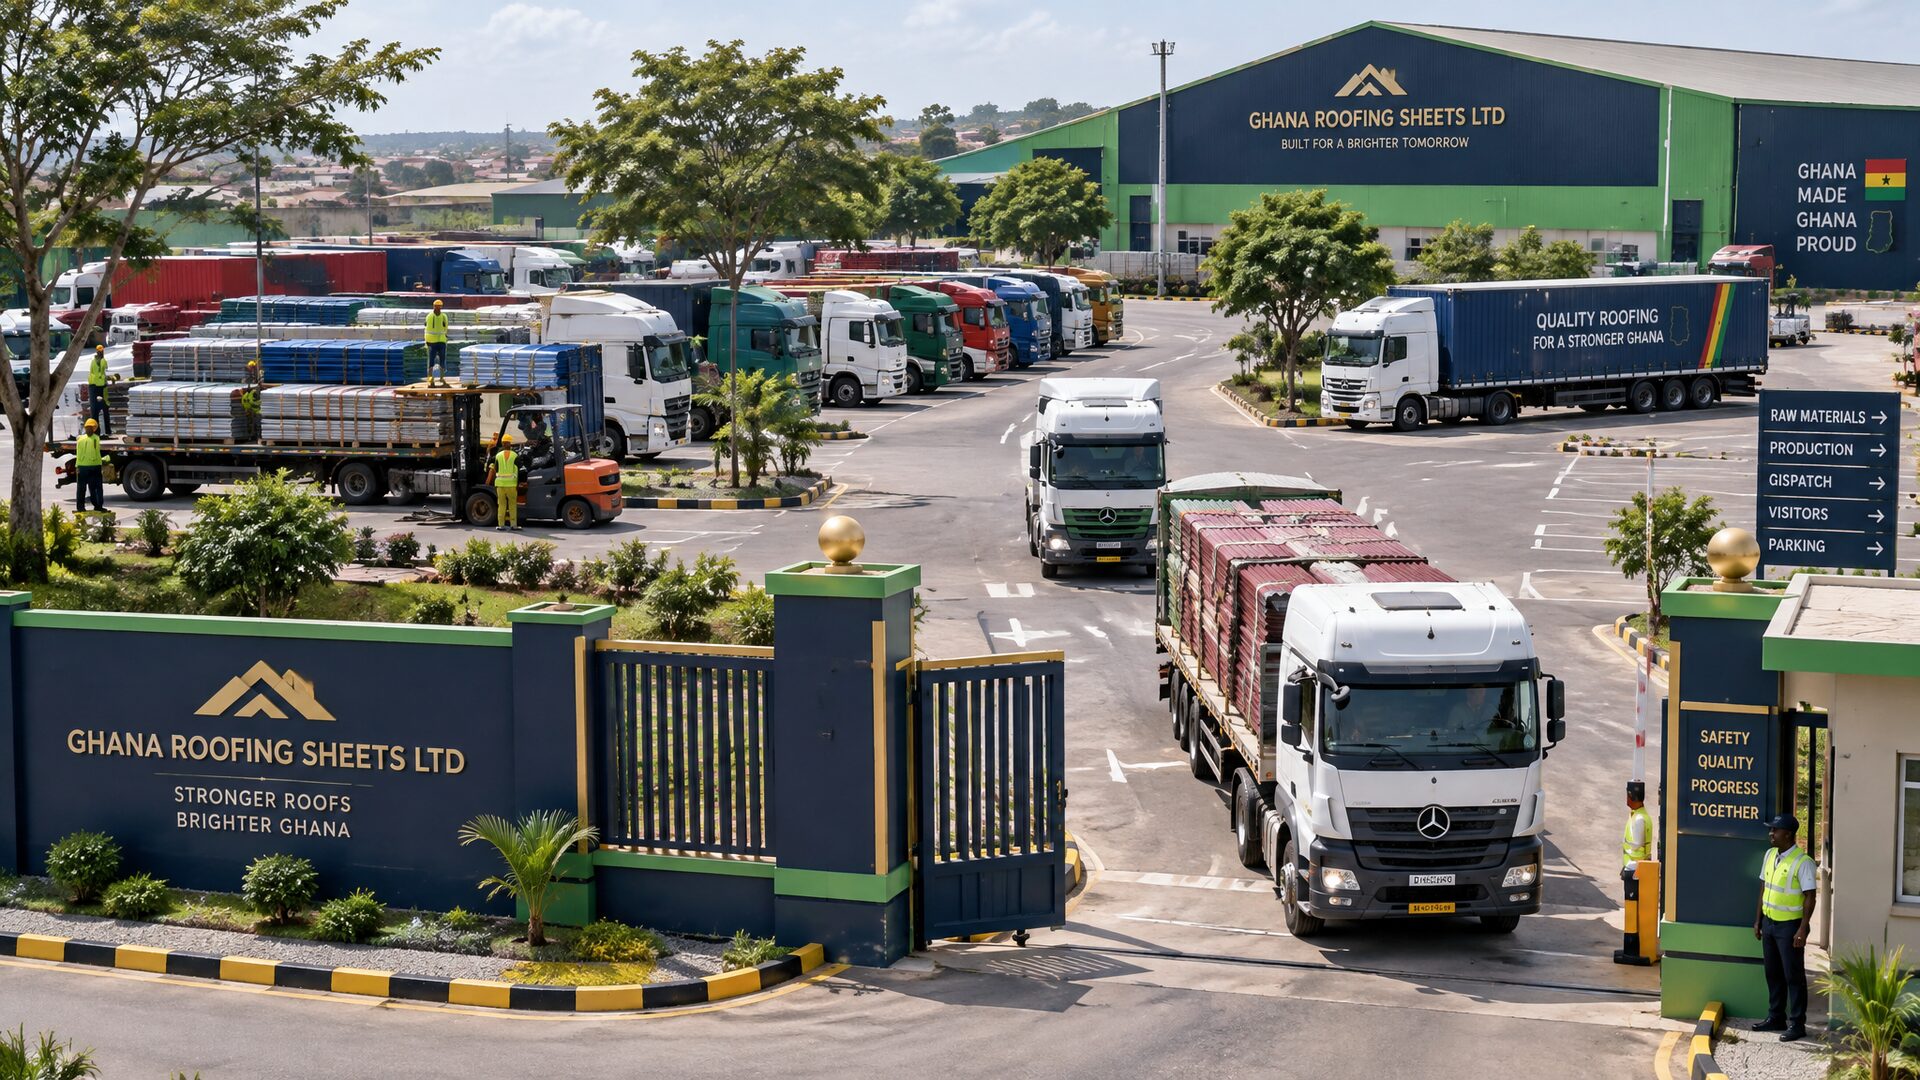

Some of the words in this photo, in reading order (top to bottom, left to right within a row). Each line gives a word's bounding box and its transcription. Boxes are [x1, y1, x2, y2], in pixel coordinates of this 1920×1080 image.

[1250, 111, 1309, 129] GHANA
[1315, 109, 1393, 127] ROOFING
[1400, 108, 1465, 126] SHEETS
[1472, 107, 1505, 125] LTD
[1282, 139, 1309, 149] BUILT
[1313, 139, 1333, 148] FOR
[1337, 138, 1344, 148] A
[1348, 138, 1398, 148] BRIGHTER
[1402, 137, 1469, 148] TOMORROW
[1798, 163, 1856, 179] GHANA
[1798, 187, 1846, 203] MADE
[1797, 212, 1857, 227] GHANA
[1797, 236, 1856, 251] PROUD
[1537, 312, 1595, 330] QUALITY
[1600, 309, 1658, 325] ROOFING
[1534, 336, 1554, 350] FOR
[1558, 336, 1565, 348] A
[1568, 332, 1624, 347] STRONGER
[1627, 330, 1664, 344] GHANA
[1771, 409, 1797, 421] RAW
[1801, 410, 1865, 424] MATERIALS
[1771, 442, 1853, 455] PRODUCTION
[1769, 474, 1831, 488] GISPATCH
[1769, 506, 1828, 520] VISITORS
[1769, 538, 1825, 552] PARKING
[1701, 730, 1750, 744] SAFETY
[68, 729, 163, 757] GHANA
[172, 735, 293, 764] ROOFING
[302, 741, 405, 770] SHEETS
[415, 747, 464, 773] LTD
[1698, 755, 1753, 770] QUALITY
[1692, 779, 1759, 795] PROGRESS
[175, 786, 275, 808] STRONGER
[285, 793, 350, 812] ROOFS
[1691, 803, 1758, 819] TOGETHER
[177, 812, 271, 833] BRIGHTER
[280, 818, 350, 837] GHANA
